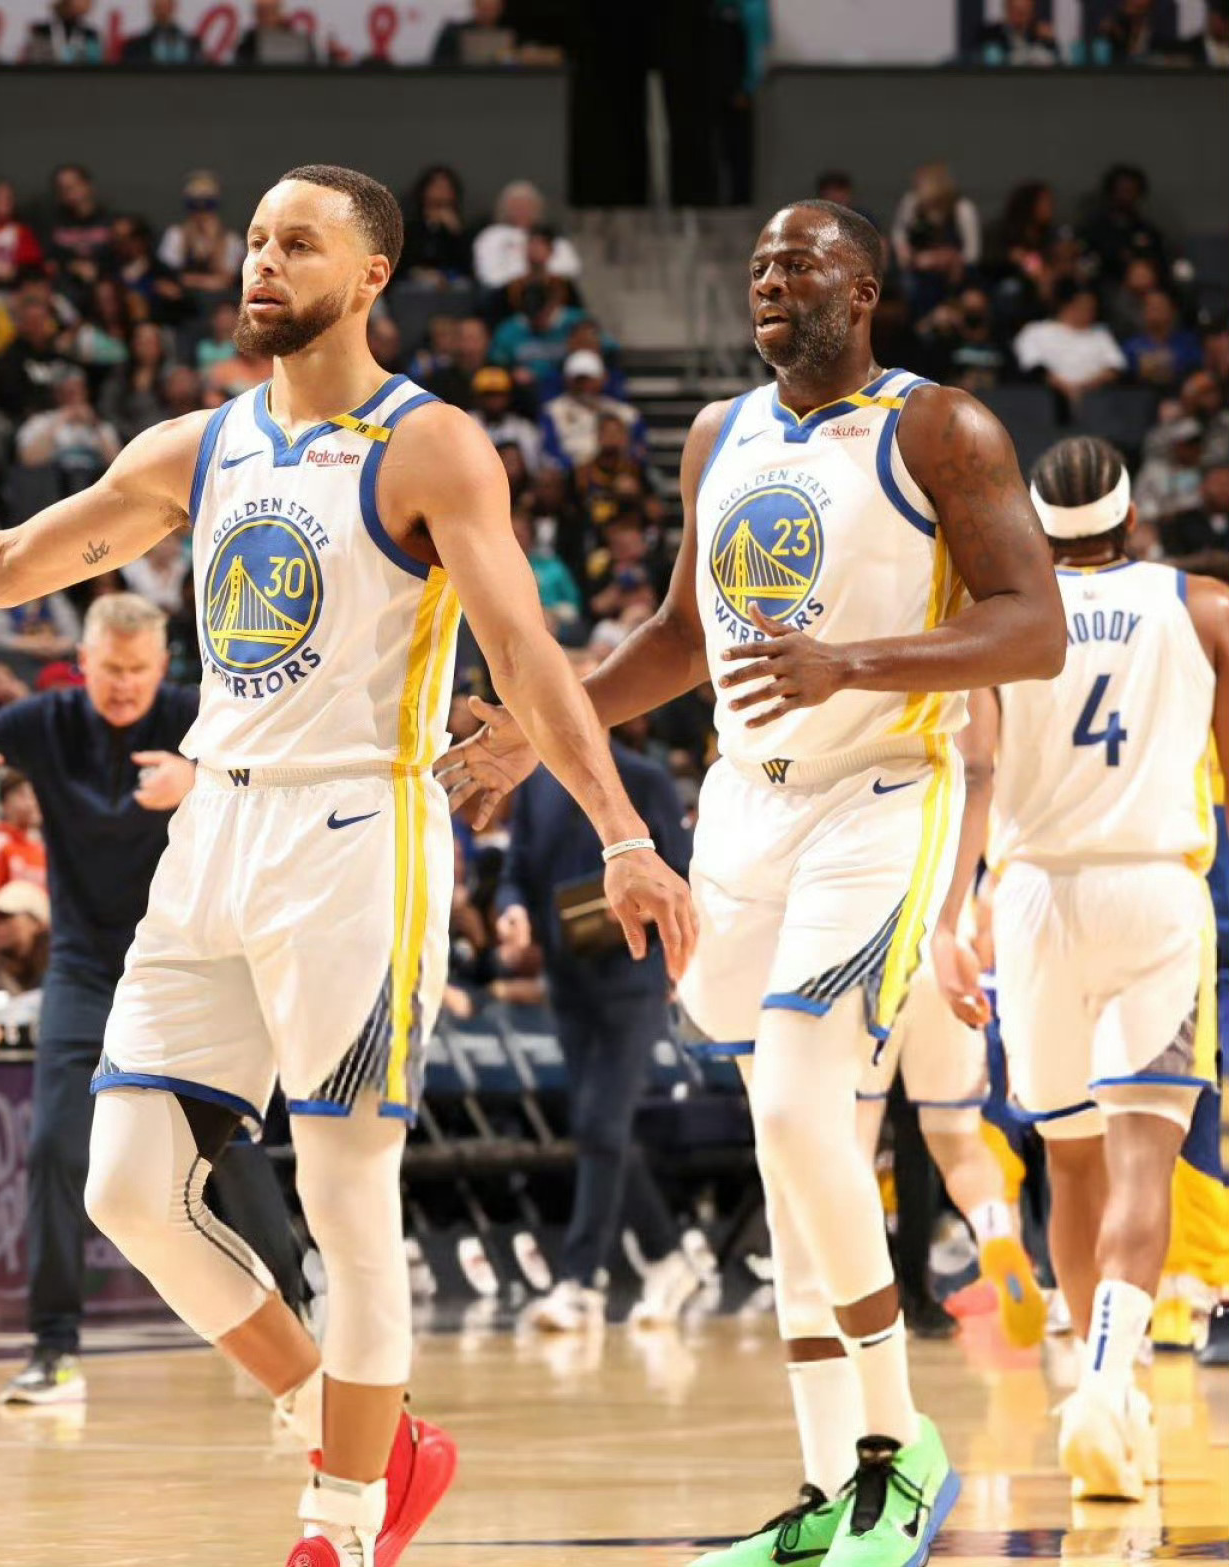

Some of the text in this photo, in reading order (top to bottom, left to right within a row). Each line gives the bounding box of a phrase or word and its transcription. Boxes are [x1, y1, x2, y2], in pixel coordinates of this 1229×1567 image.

[354, 423, 369, 433] 16
[820, 425, 870, 439] Rakuten
[307, 450, 360, 467] Rakuten
[719, 469, 832, 511] GOLDEN STATE
[213, 498, 330, 550] GOLDEN STATE
[771, 517, 811, 557] 23
[263, 556, 306, 599] 30
[715, 597, 824, 643] WARRRS
[1067, 610, 1142, 645] OODY
[1073, 673, 1127, 767] 4
